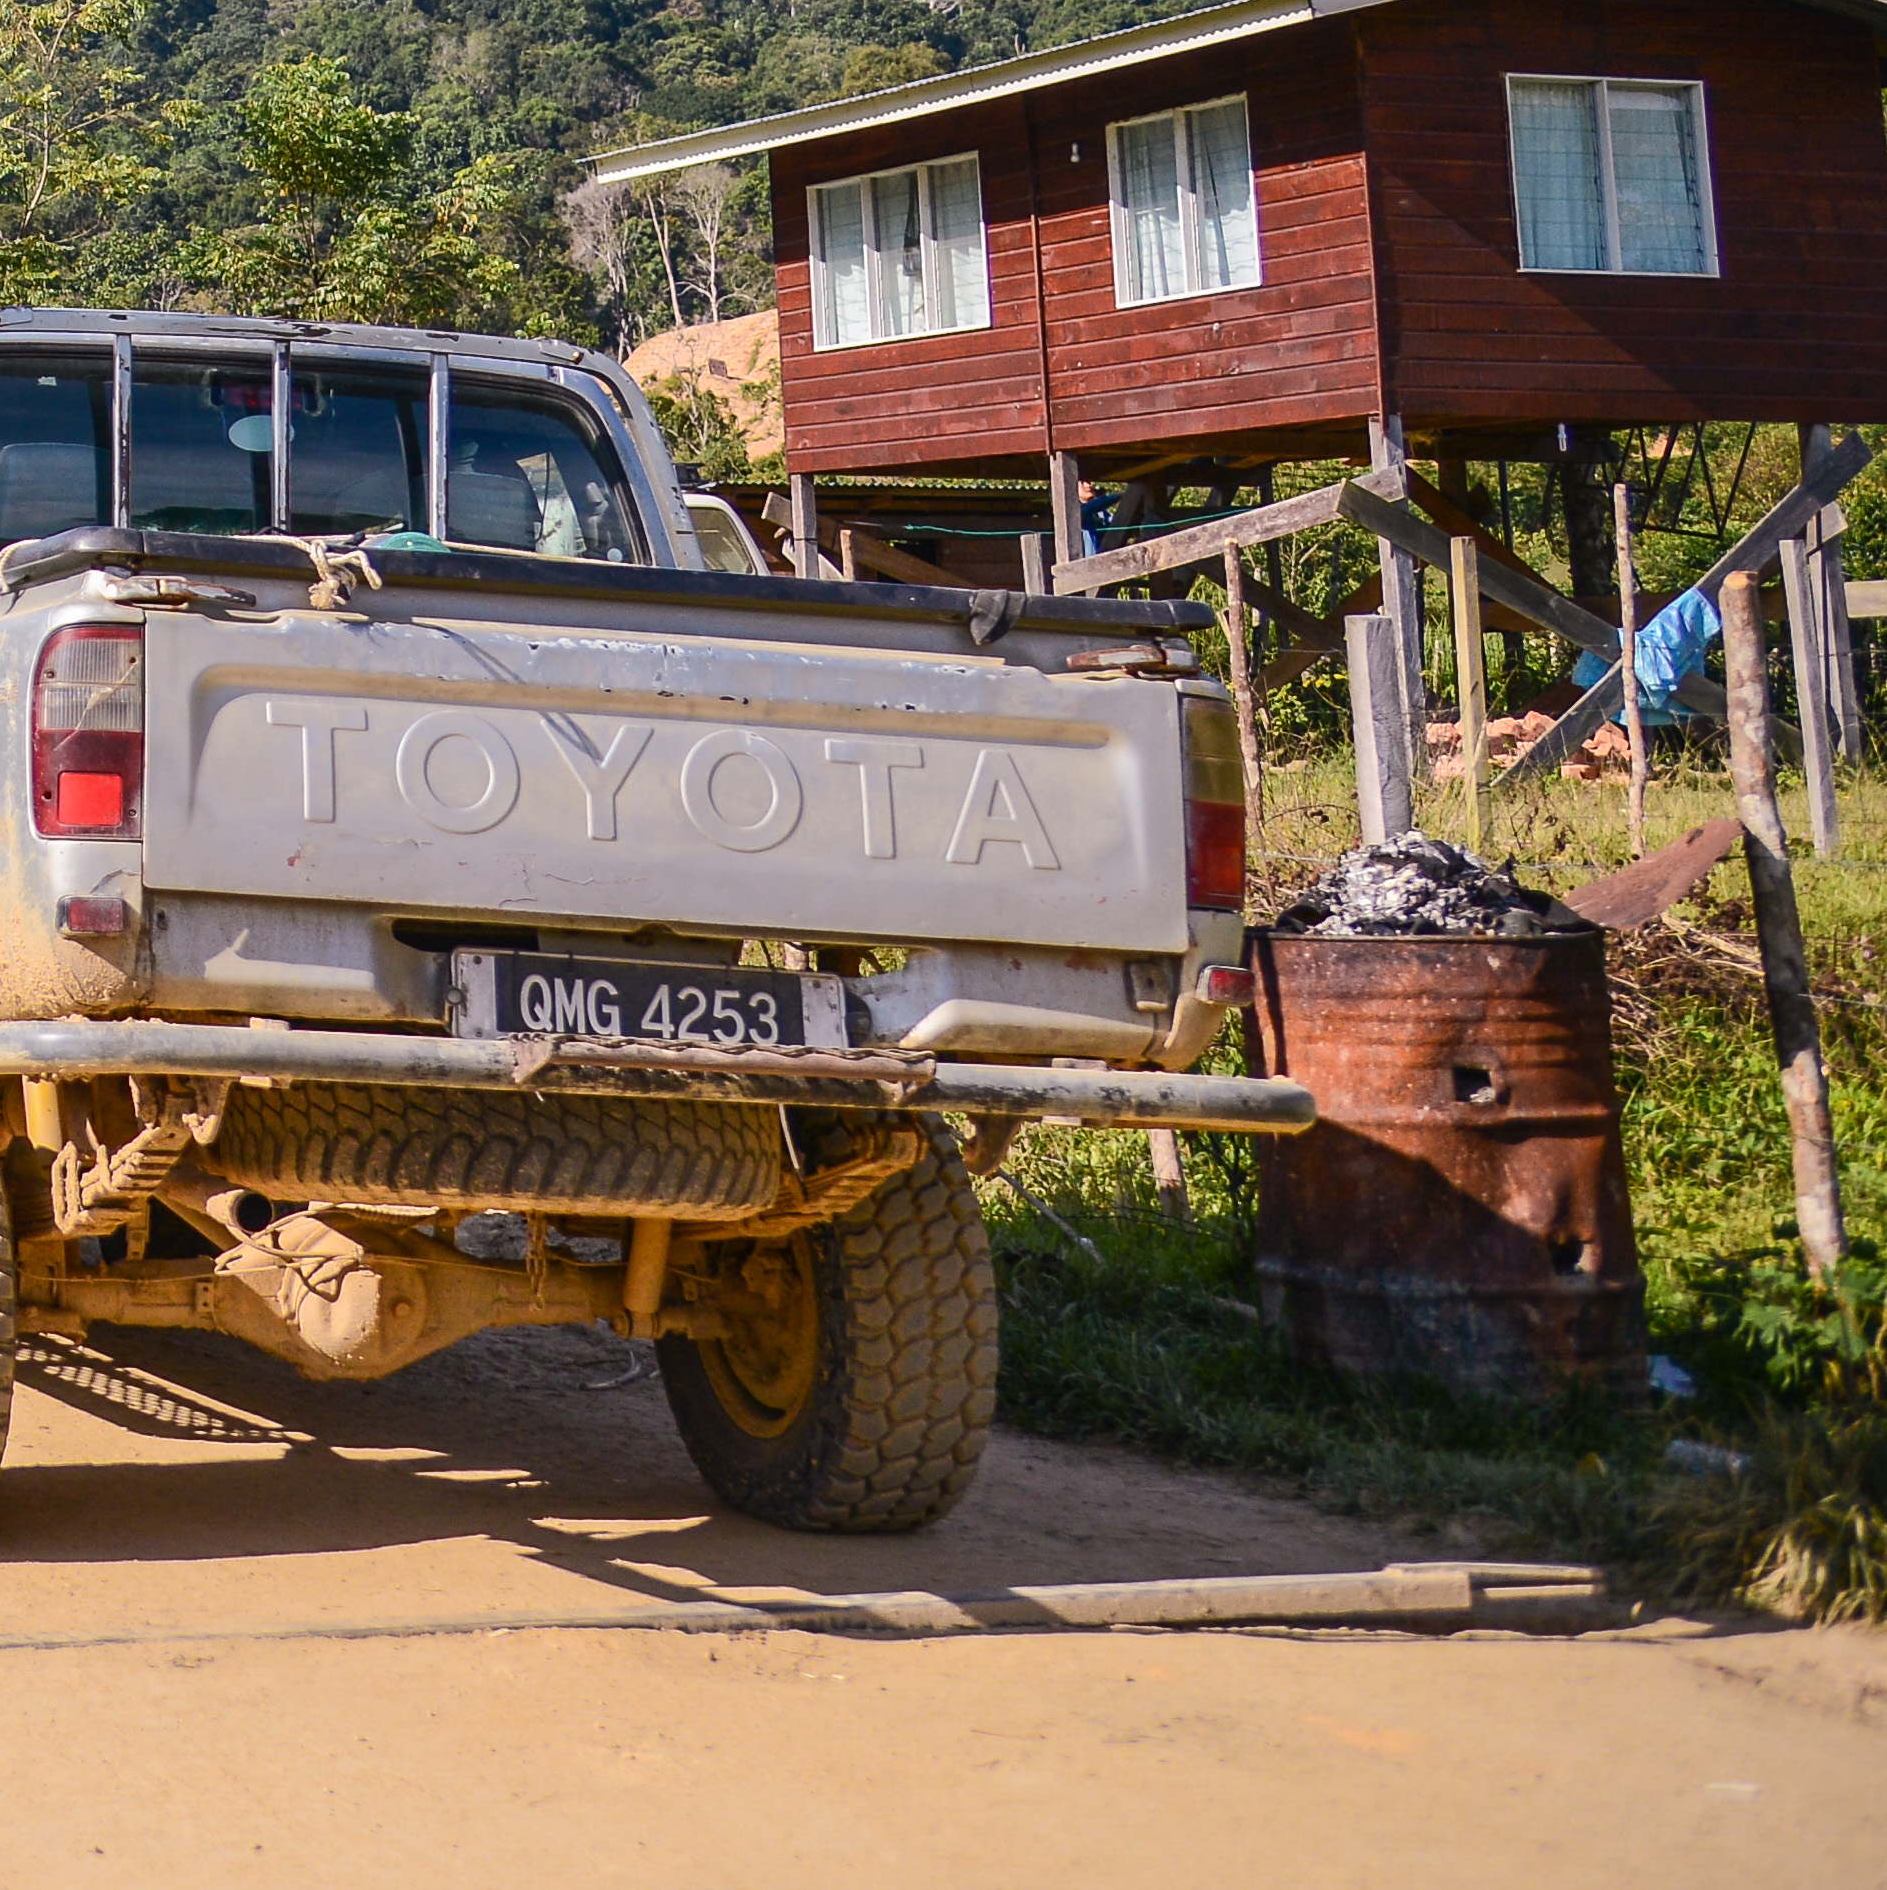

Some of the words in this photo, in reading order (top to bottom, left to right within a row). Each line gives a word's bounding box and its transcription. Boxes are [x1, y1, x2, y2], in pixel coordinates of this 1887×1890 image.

[266, 701, 1061, 870] TOYOTA
[520, 974, 623, 1036] QMG
[640, 984, 779, 1045] 4253
